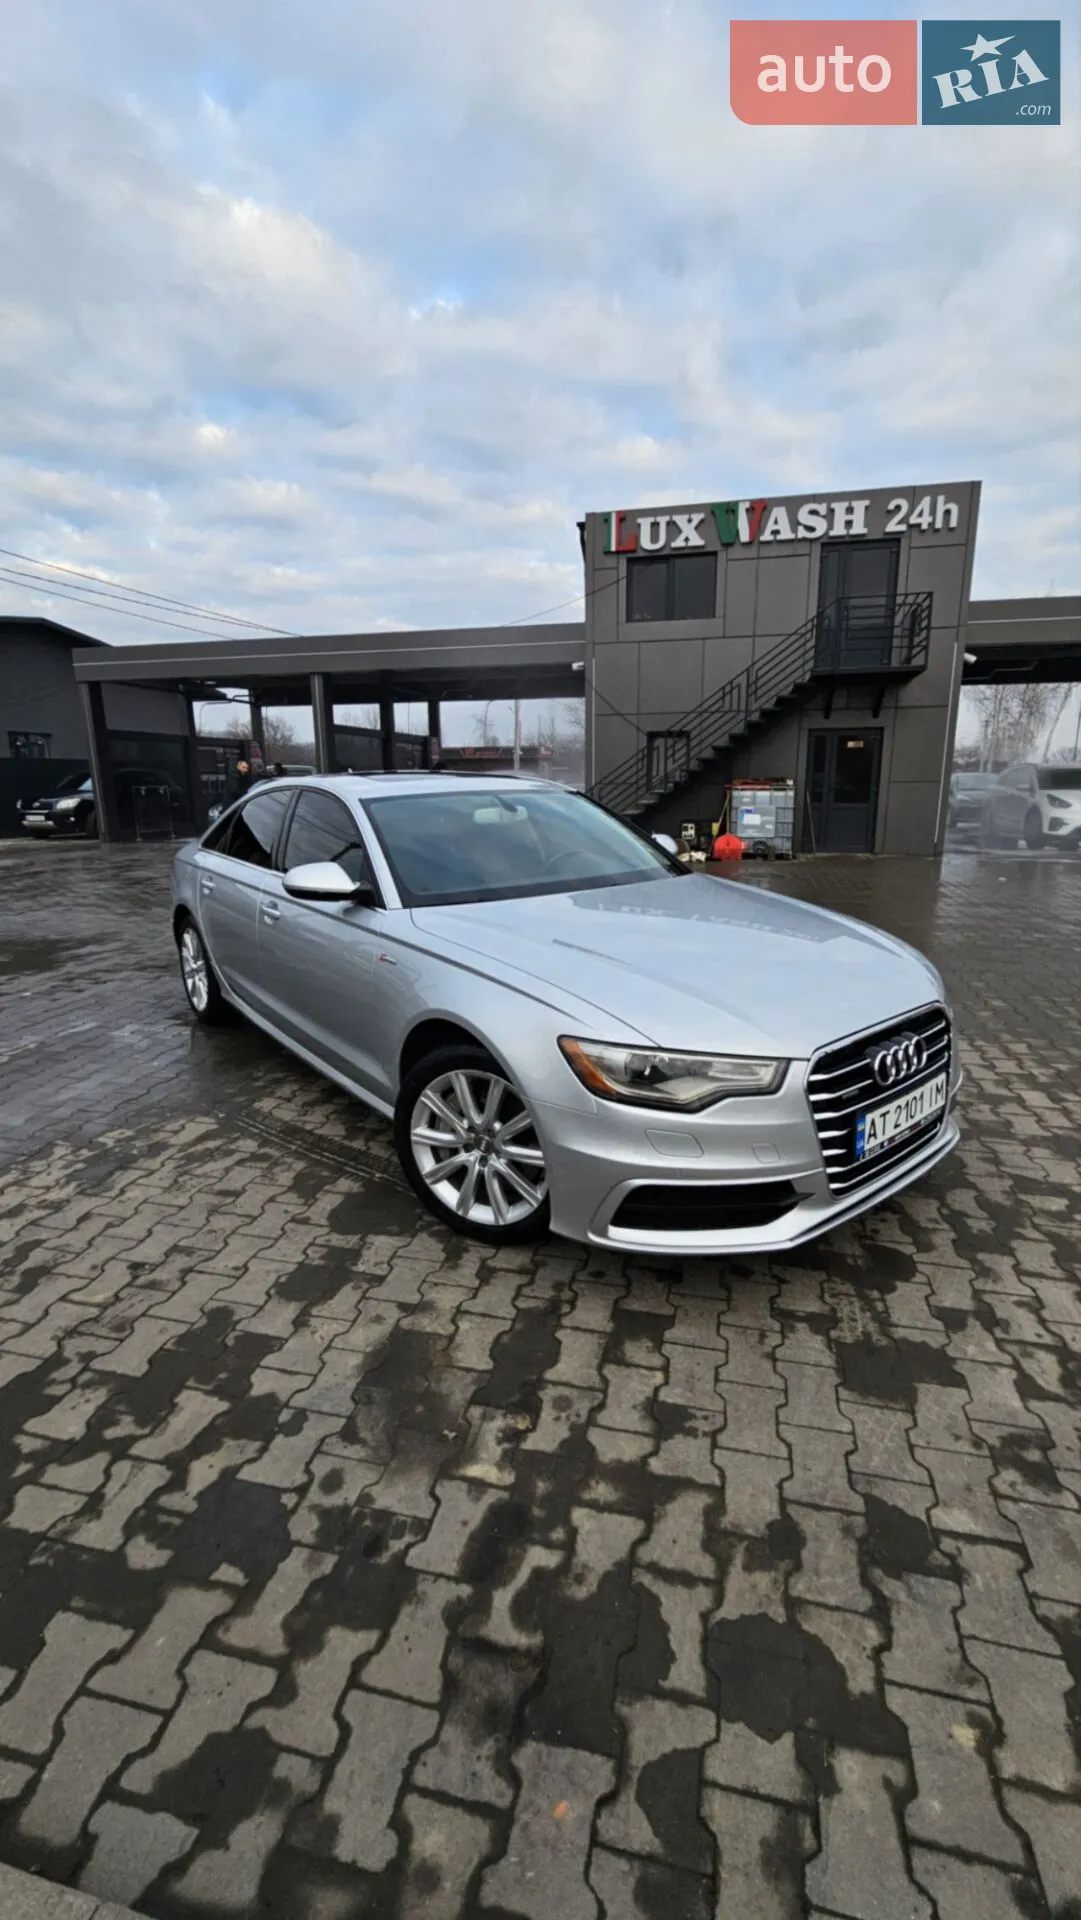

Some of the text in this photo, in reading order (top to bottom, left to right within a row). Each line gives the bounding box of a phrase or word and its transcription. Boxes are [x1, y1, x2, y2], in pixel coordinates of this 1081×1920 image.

[603, 495, 959, 553] LUX WASH 24h
[867, 1109, 891, 1145] AT
[893, 1090, 925, 1130] 2101
[929, 1079, 945, 1108] IM
